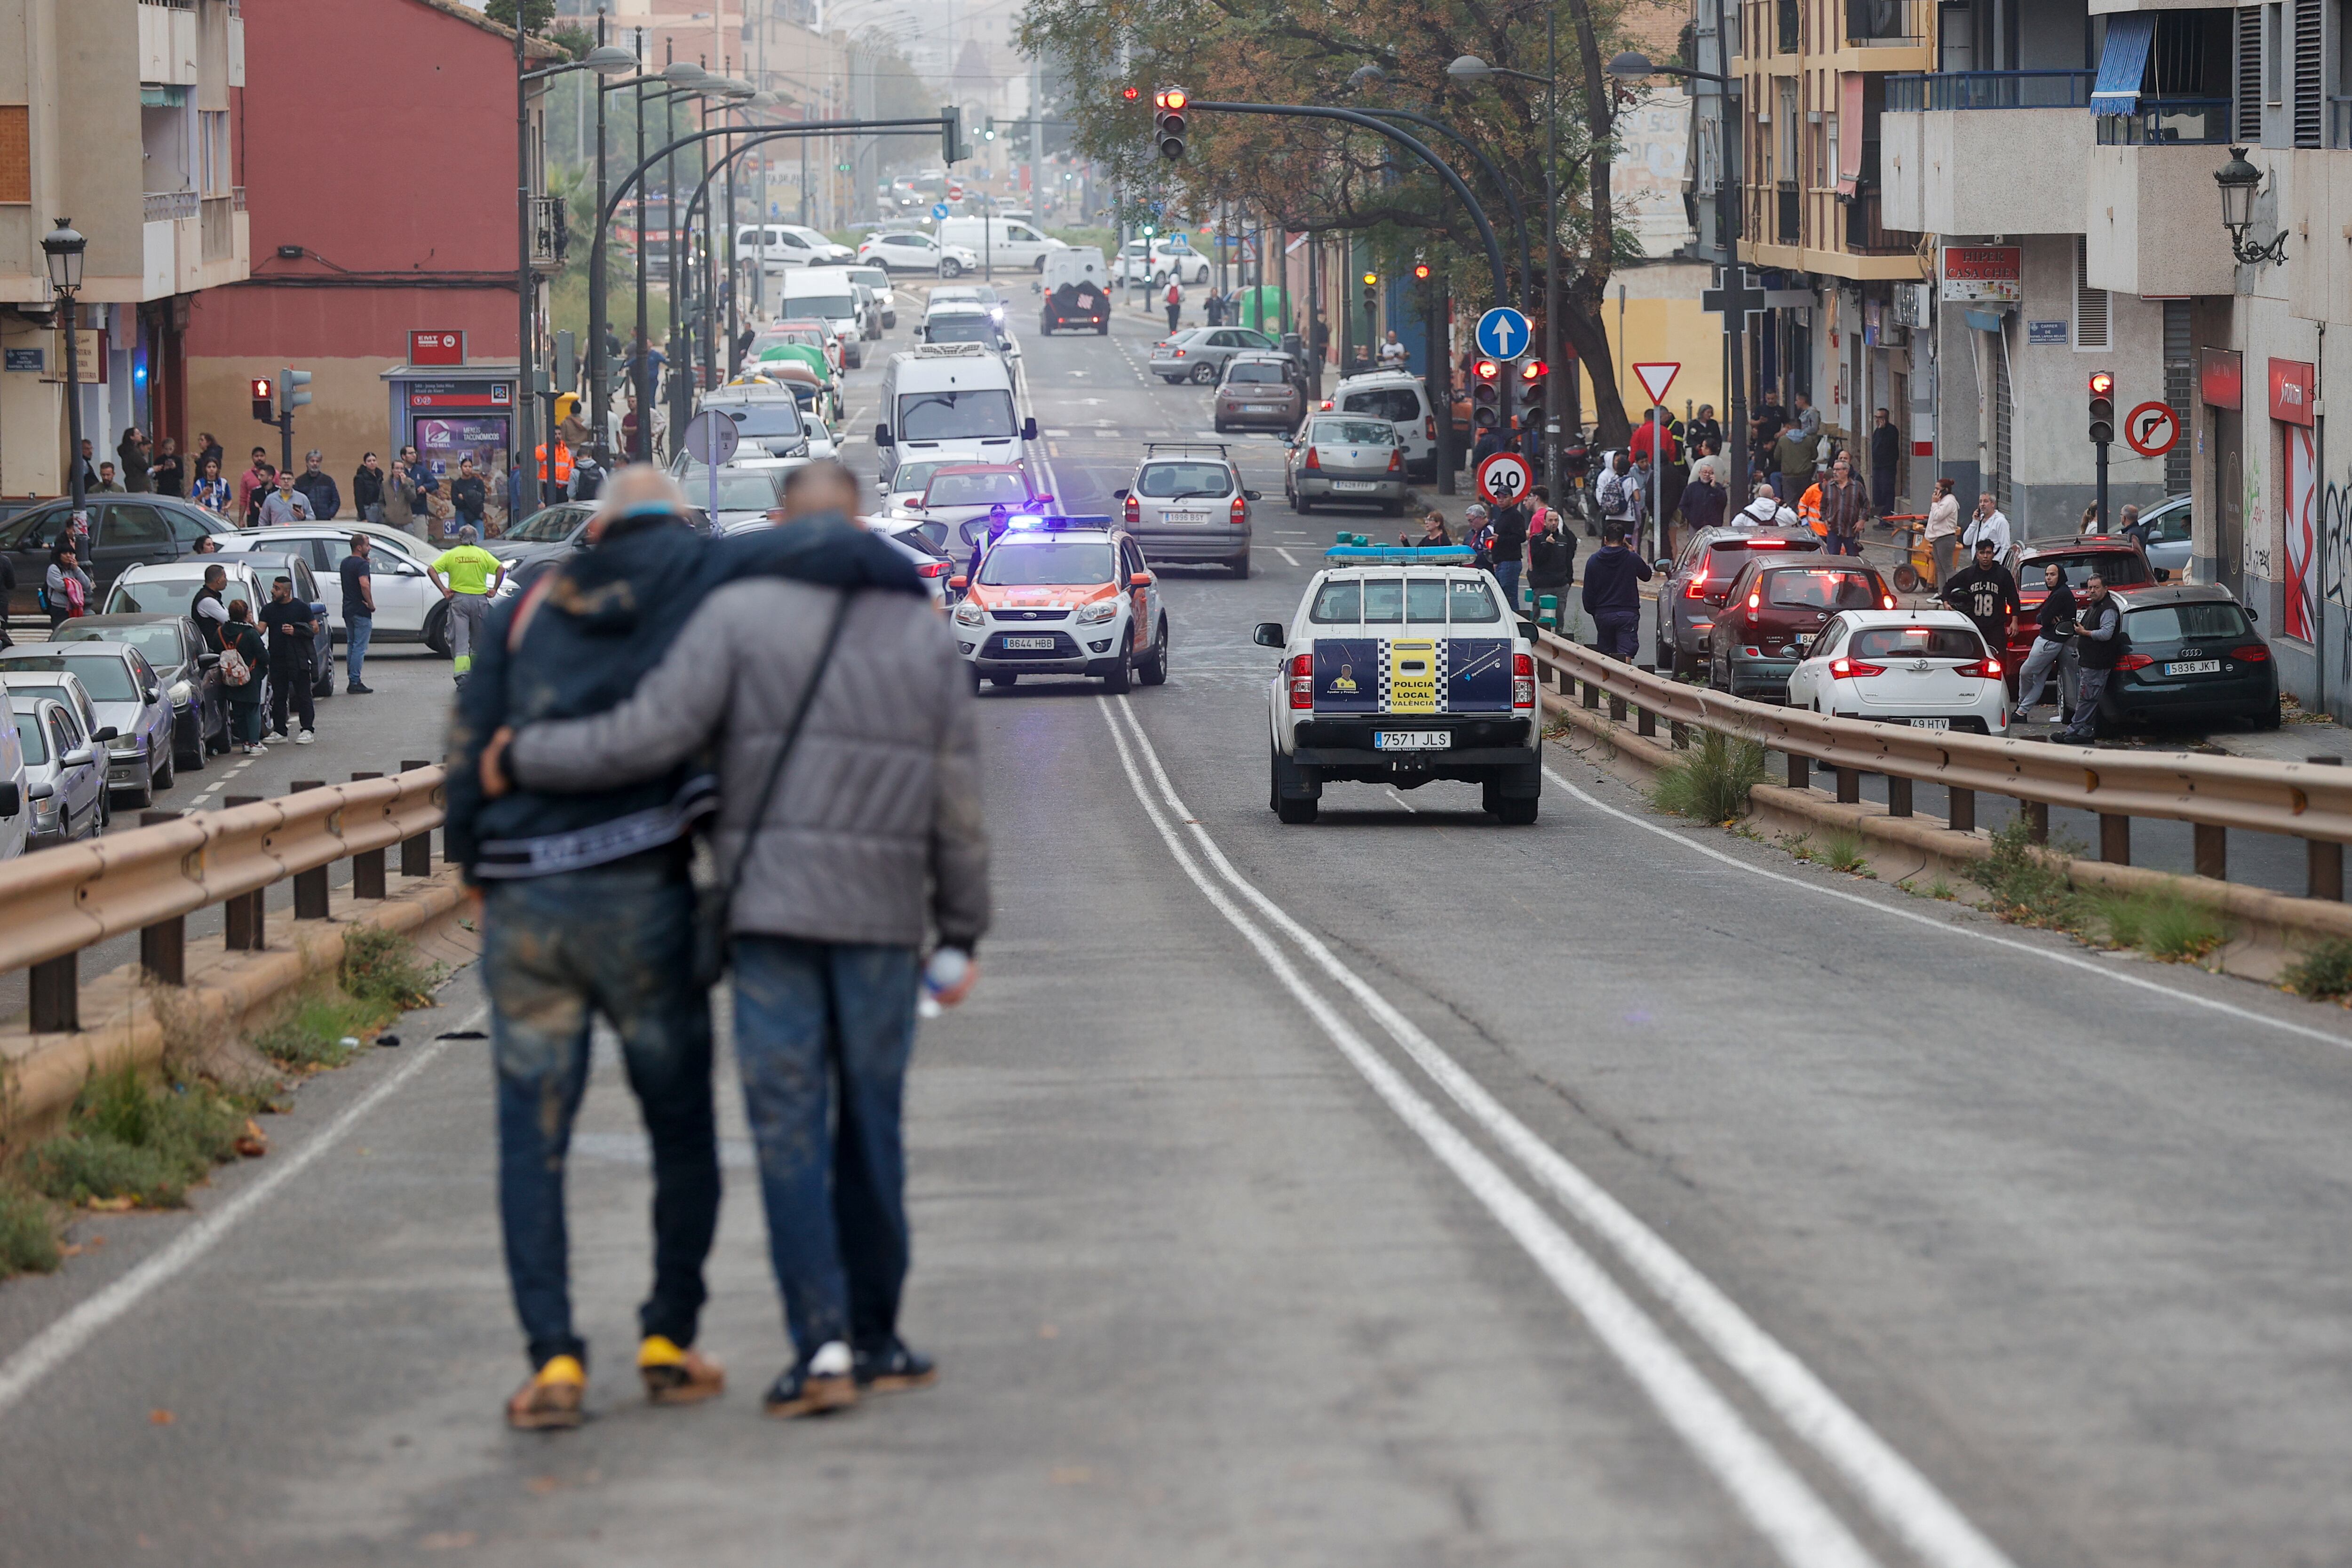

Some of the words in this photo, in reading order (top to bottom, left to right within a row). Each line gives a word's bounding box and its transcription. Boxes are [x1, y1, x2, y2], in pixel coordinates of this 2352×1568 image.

[1963, 251, 2005, 263] HIPER
[1947, 268, 1980, 279] CASA
[1983, 268, 2019, 279] CHEN
[463, 432, 500, 441] TACONÓMICOS
[1489, 471, 1520, 488] 40
[1456, 584, 1485, 593] PLV
[1970, 581, 1998, 594] BEL-AIR
[1974, 594, 1993, 616] 08
[1009, 639, 1032, 648] 8644
[1035, 639, 1052, 648] HBB
[2171, 663, 2195, 673] 5836
[2199, 661, 2216, 671] JKT
[1928, 720, 1947, 729] HTV
[1384, 734, 1415, 745] 7571
[1422, 734, 1446, 745] JLS
